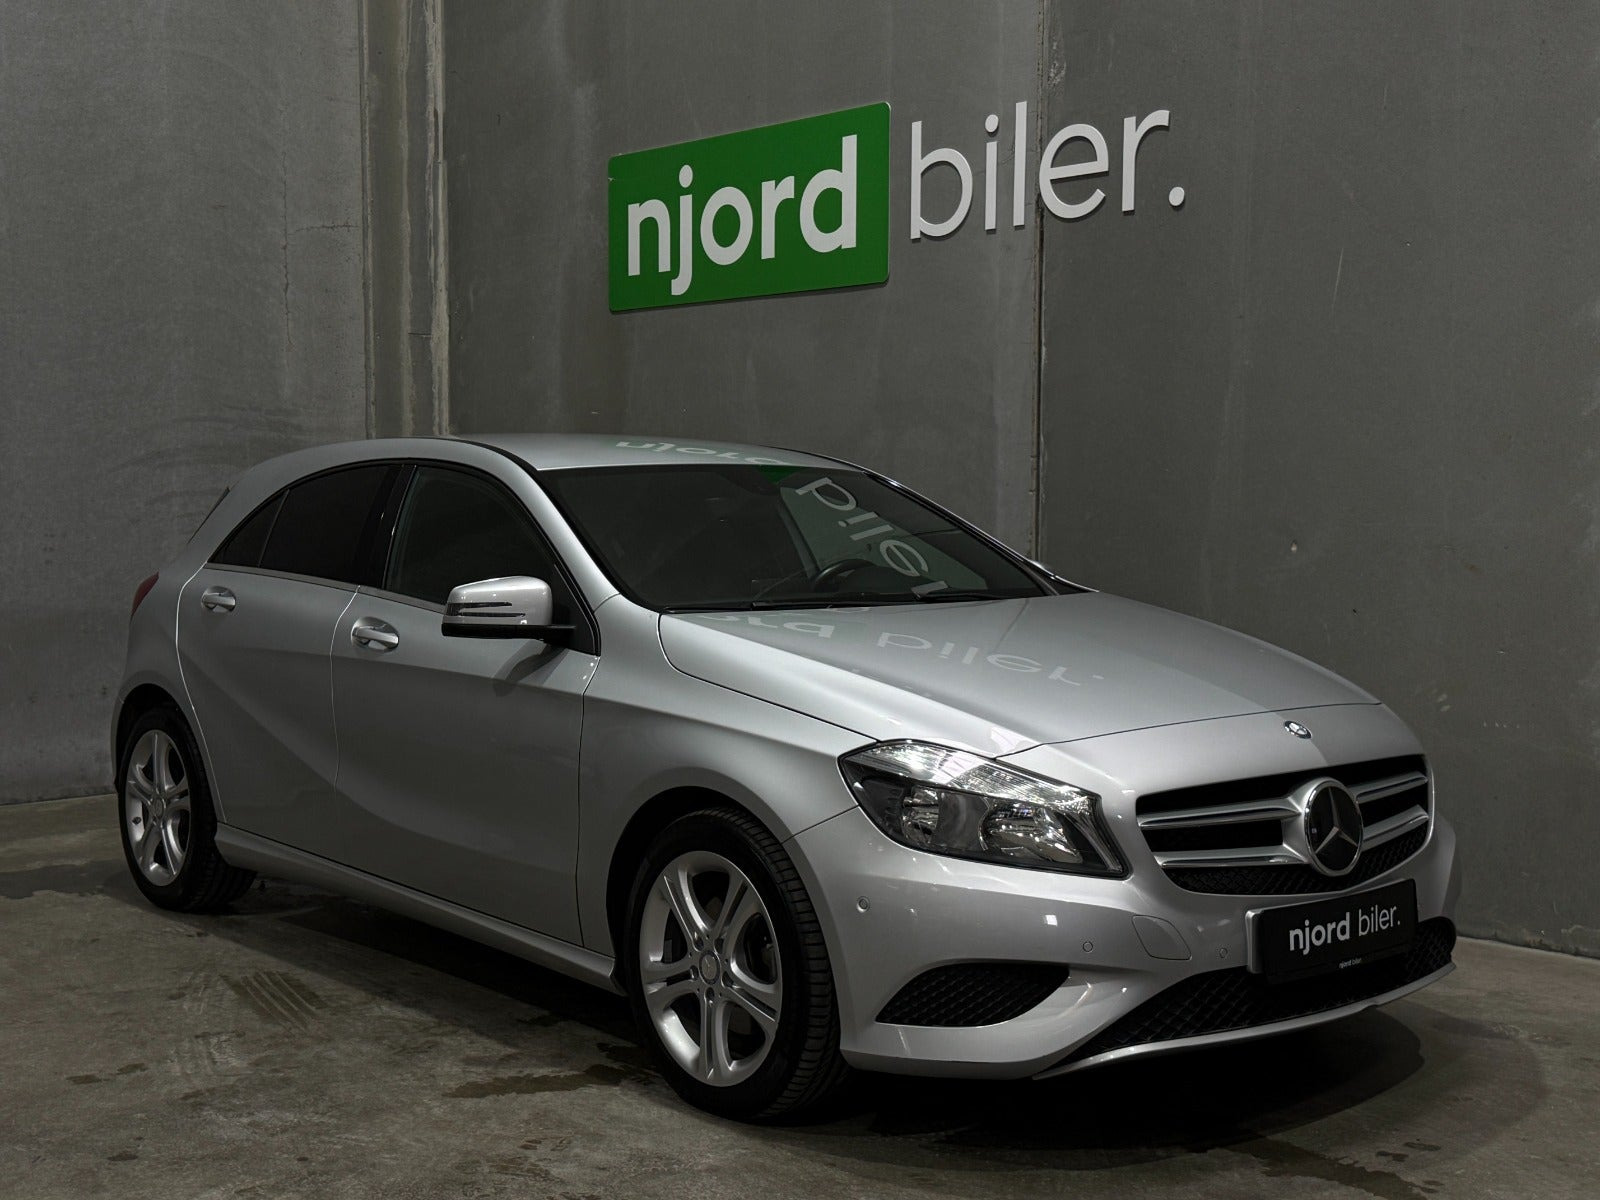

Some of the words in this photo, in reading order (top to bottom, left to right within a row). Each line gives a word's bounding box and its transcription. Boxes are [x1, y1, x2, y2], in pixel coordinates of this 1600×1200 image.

[627, 133, 858, 296] njord
[910, 100, 1186, 241] biler.
[1289, 911, 1350, 956] njord
[1358, 904, 1401, 937] biler.
